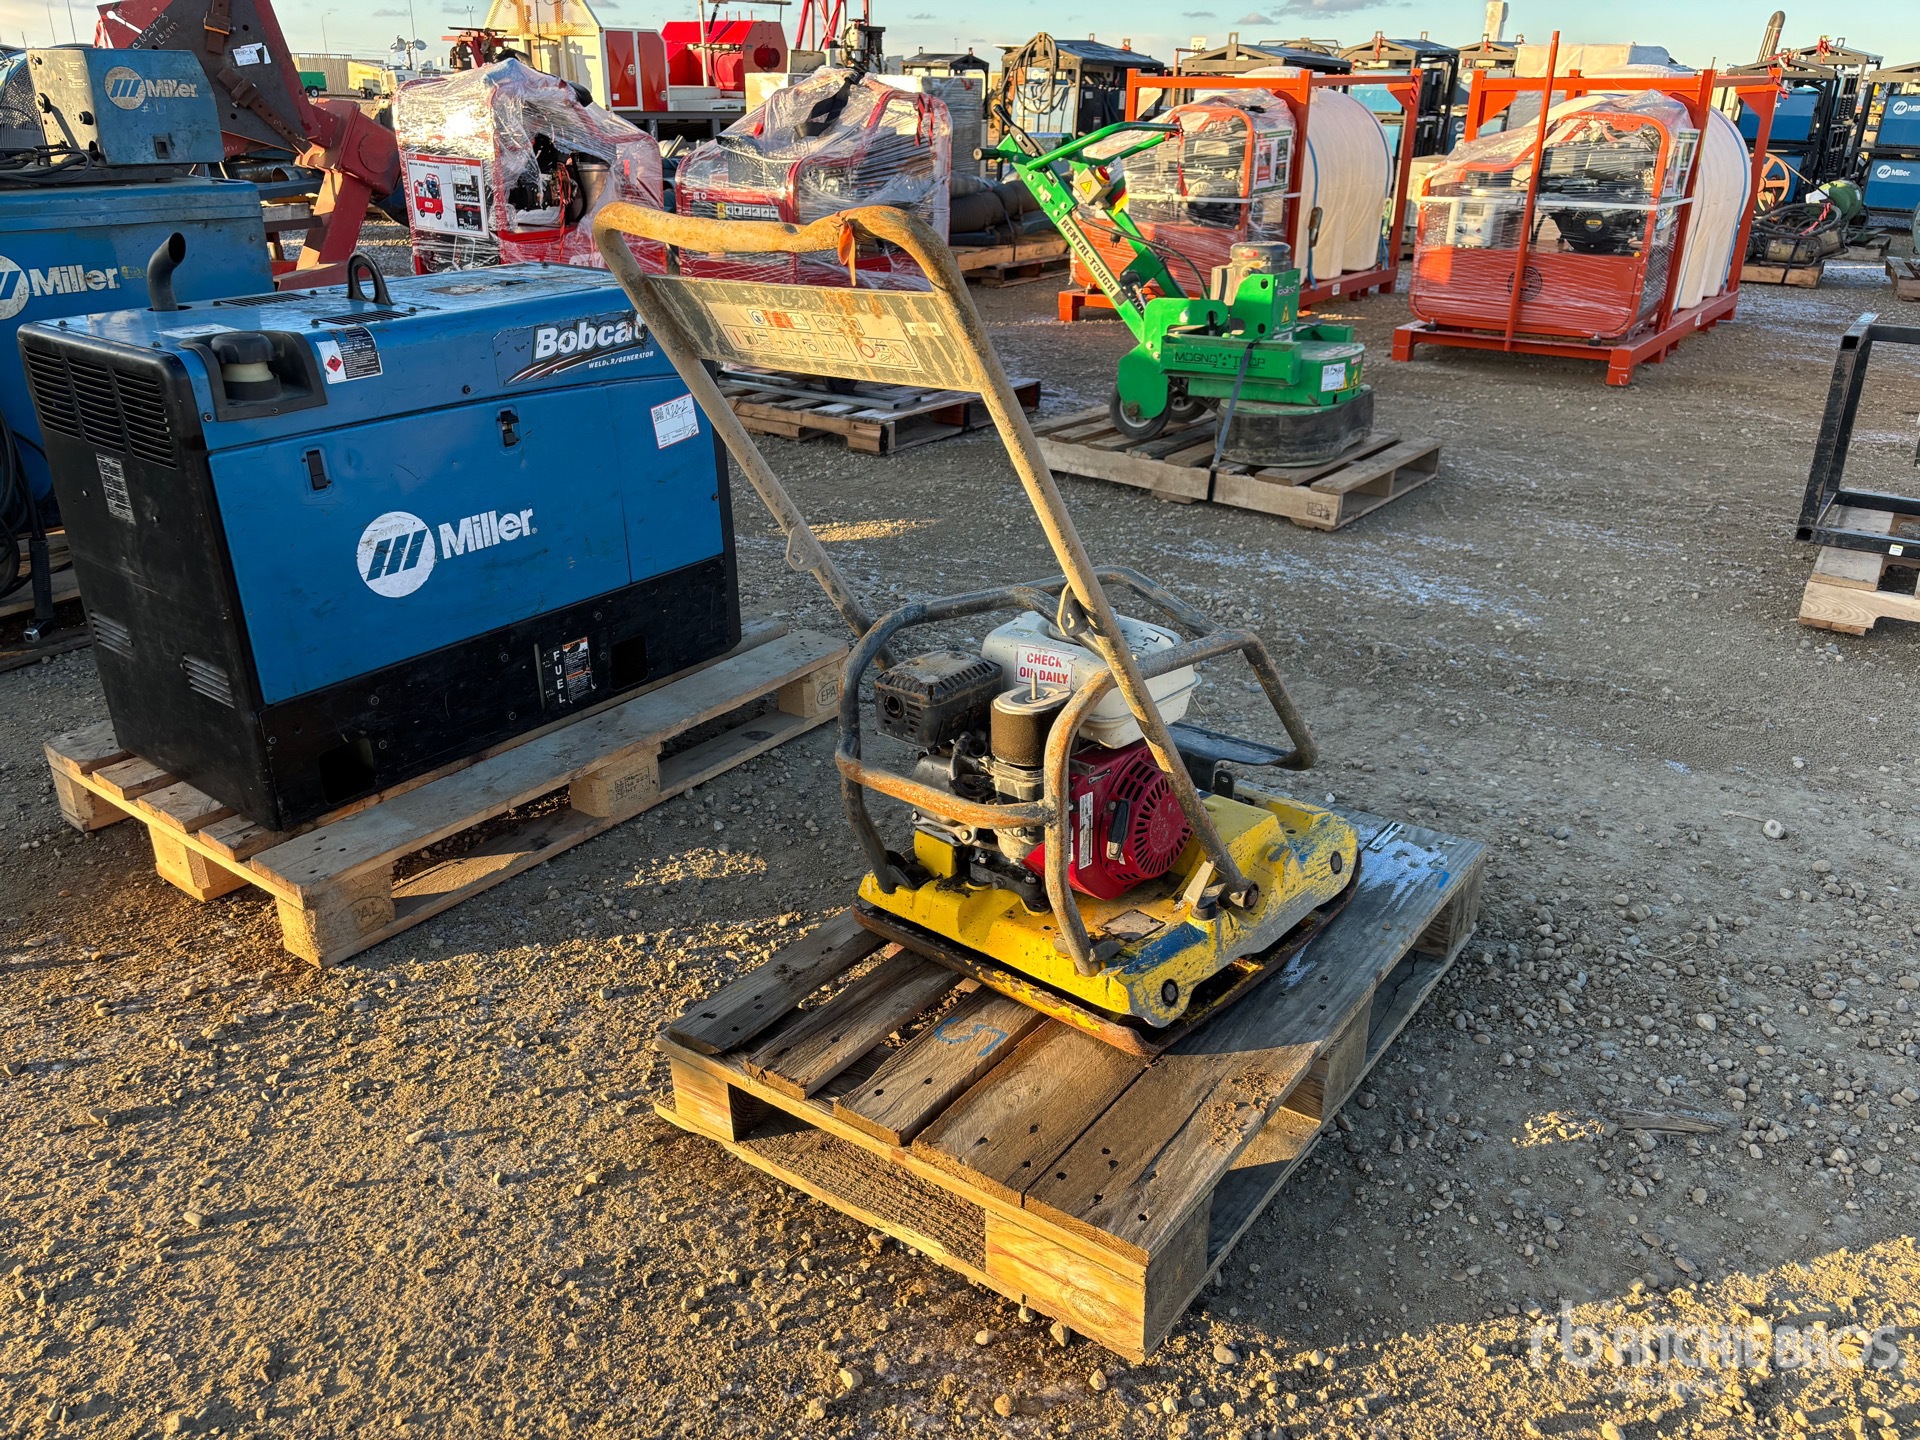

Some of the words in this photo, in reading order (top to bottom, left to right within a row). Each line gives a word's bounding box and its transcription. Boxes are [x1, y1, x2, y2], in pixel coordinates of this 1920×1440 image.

[145, 79, 198, 98] Miller
[1891, 168, 1911, 177] Miller
[1061, 219, 1116, 293] RENTAL-TOUGH
[29, 264, 119, 297] Miller
[535, 313, 647, 360] Bobcat
[588, 350, 655, 370] WELDR/GENERATOR
[438, 508, 534, 560] Miller
[1026, 652, 1063, 668] CHECK
[553, 650, 566, 704] FUEL
[1038, 669, 1069, 685] DAILY
